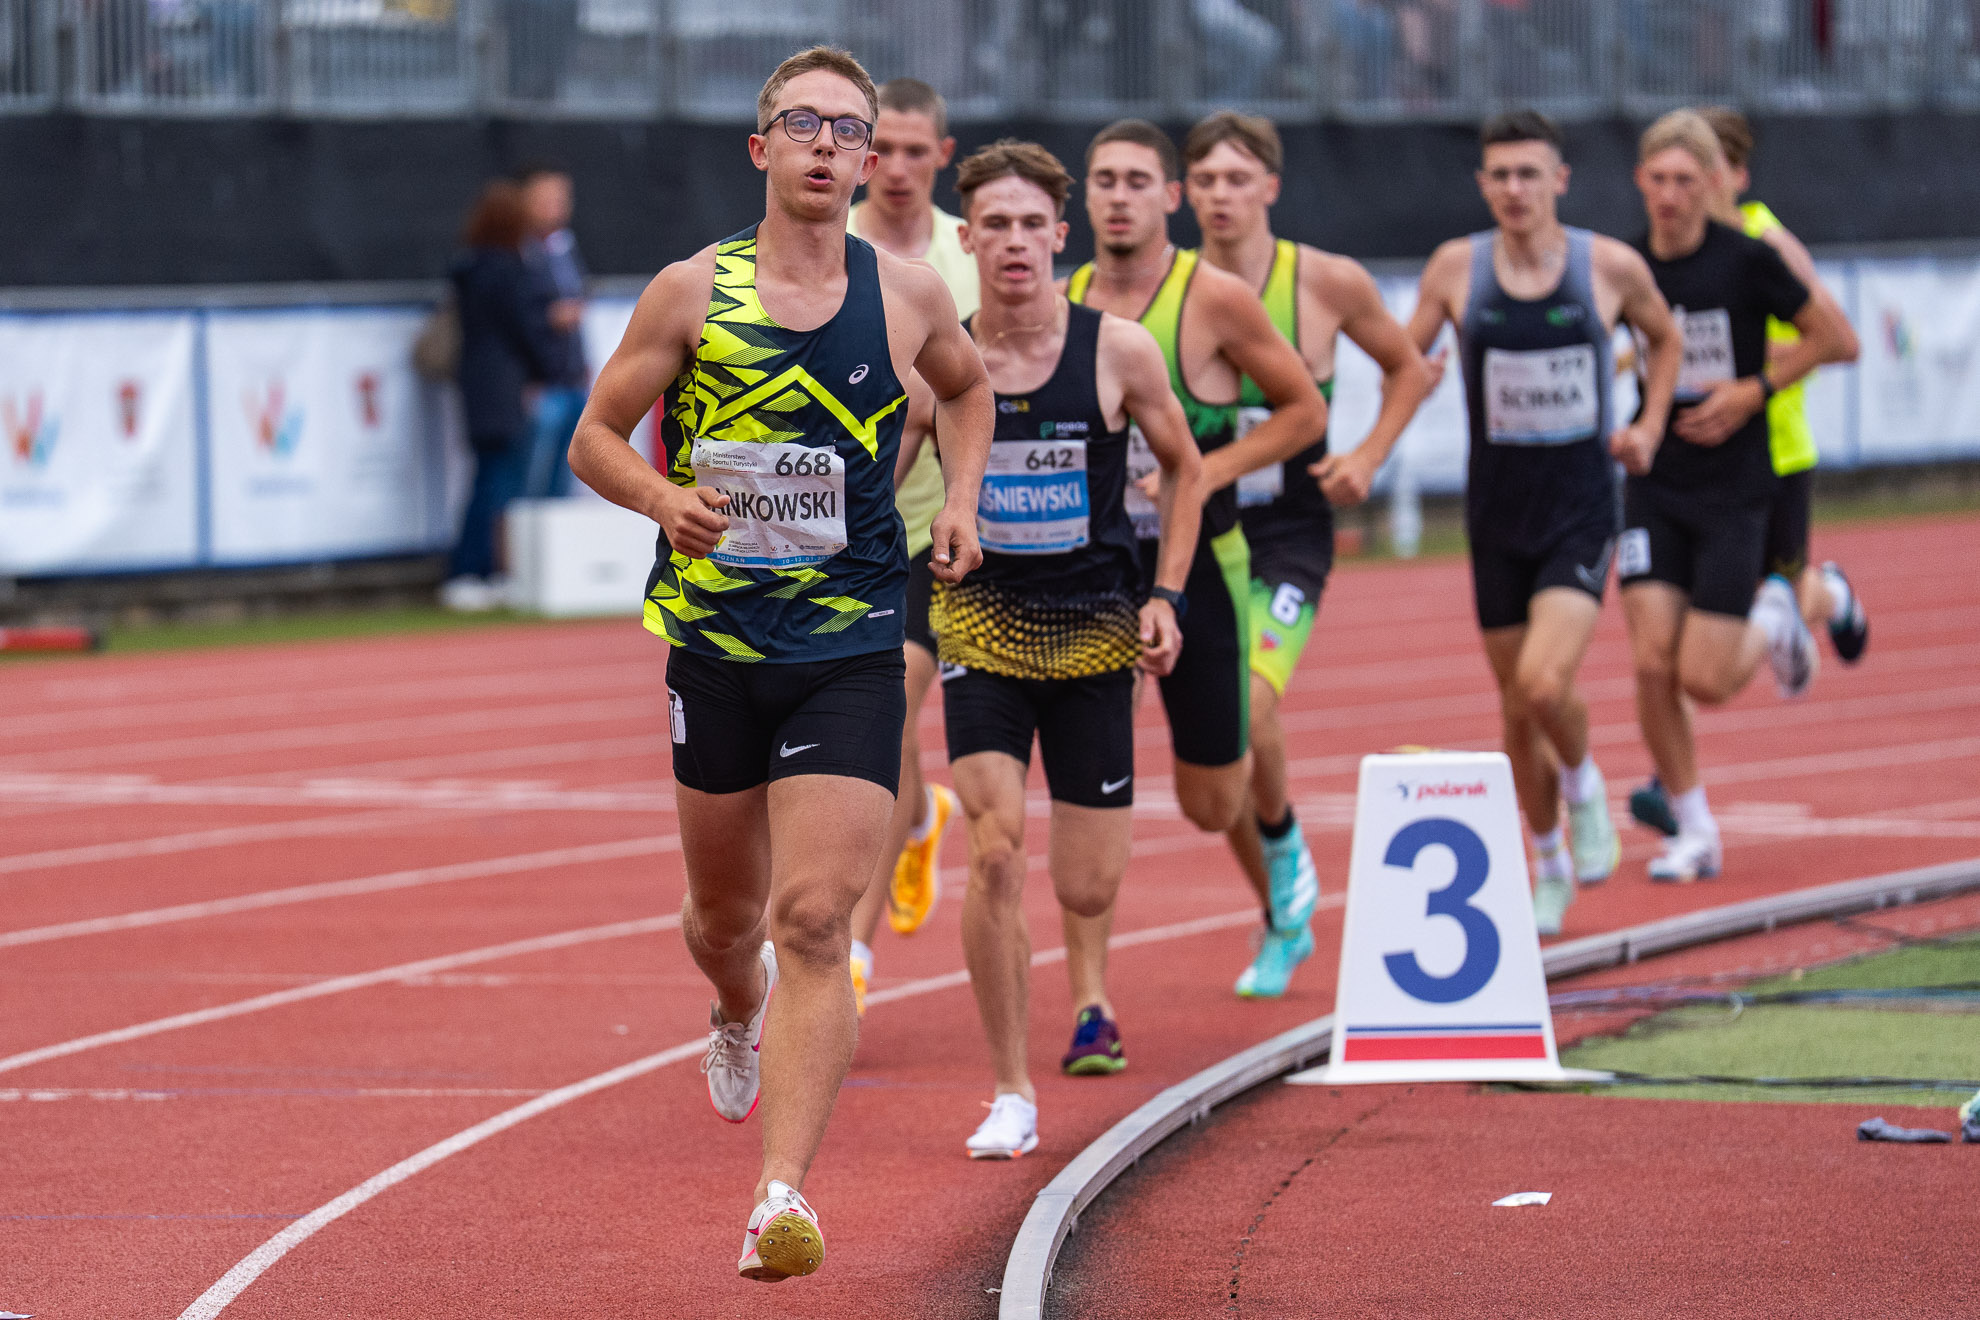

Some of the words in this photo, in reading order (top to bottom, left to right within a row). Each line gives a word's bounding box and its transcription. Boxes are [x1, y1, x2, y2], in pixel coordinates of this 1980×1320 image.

[712, 452, 746, 460] Ministerstwo
[775, 452, 832, 477] 668
[1026, 449, 1073, 470] 642
[711, 488, 836, 522] ANKOWSKI
[980, 481, 1082, 513] ŚNIEWSKI
[716, 554, 745, 563] POZNAŃ
[1271, 581, 1305, 626] 6
[1416, 779, 1487, 802] polanik
[1382, 816, 1500, 1004] 3
